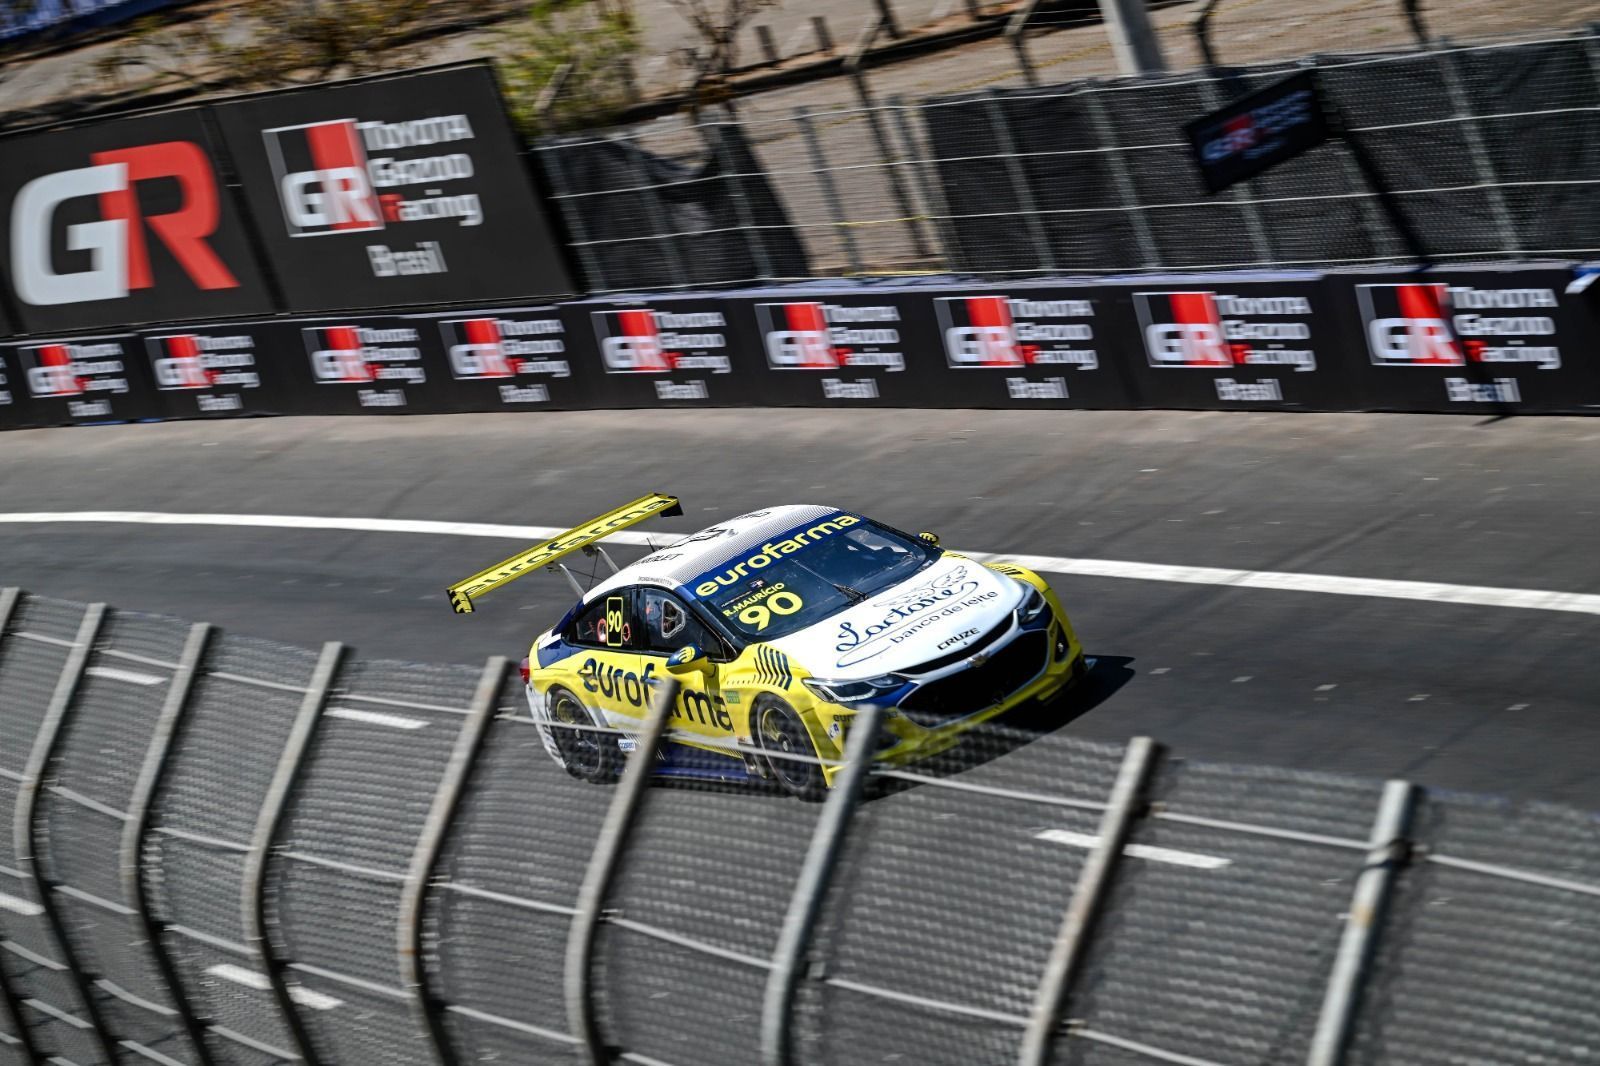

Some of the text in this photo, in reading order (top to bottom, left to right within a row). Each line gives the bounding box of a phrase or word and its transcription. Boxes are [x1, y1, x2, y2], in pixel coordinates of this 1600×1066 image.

[281, 166, 379, 227] GR
[10, 140, 240, 306] GR
[695, 514, 862, 597] eurofarma
[608, 610, 622, 633] 90
[722, 582, 785, 618] R.MAURÍCIO
[739, 591, 803, 631] 90
[890, 590, 999, 644] banco de leite
[937, 627, 981, 651] CRUZE
